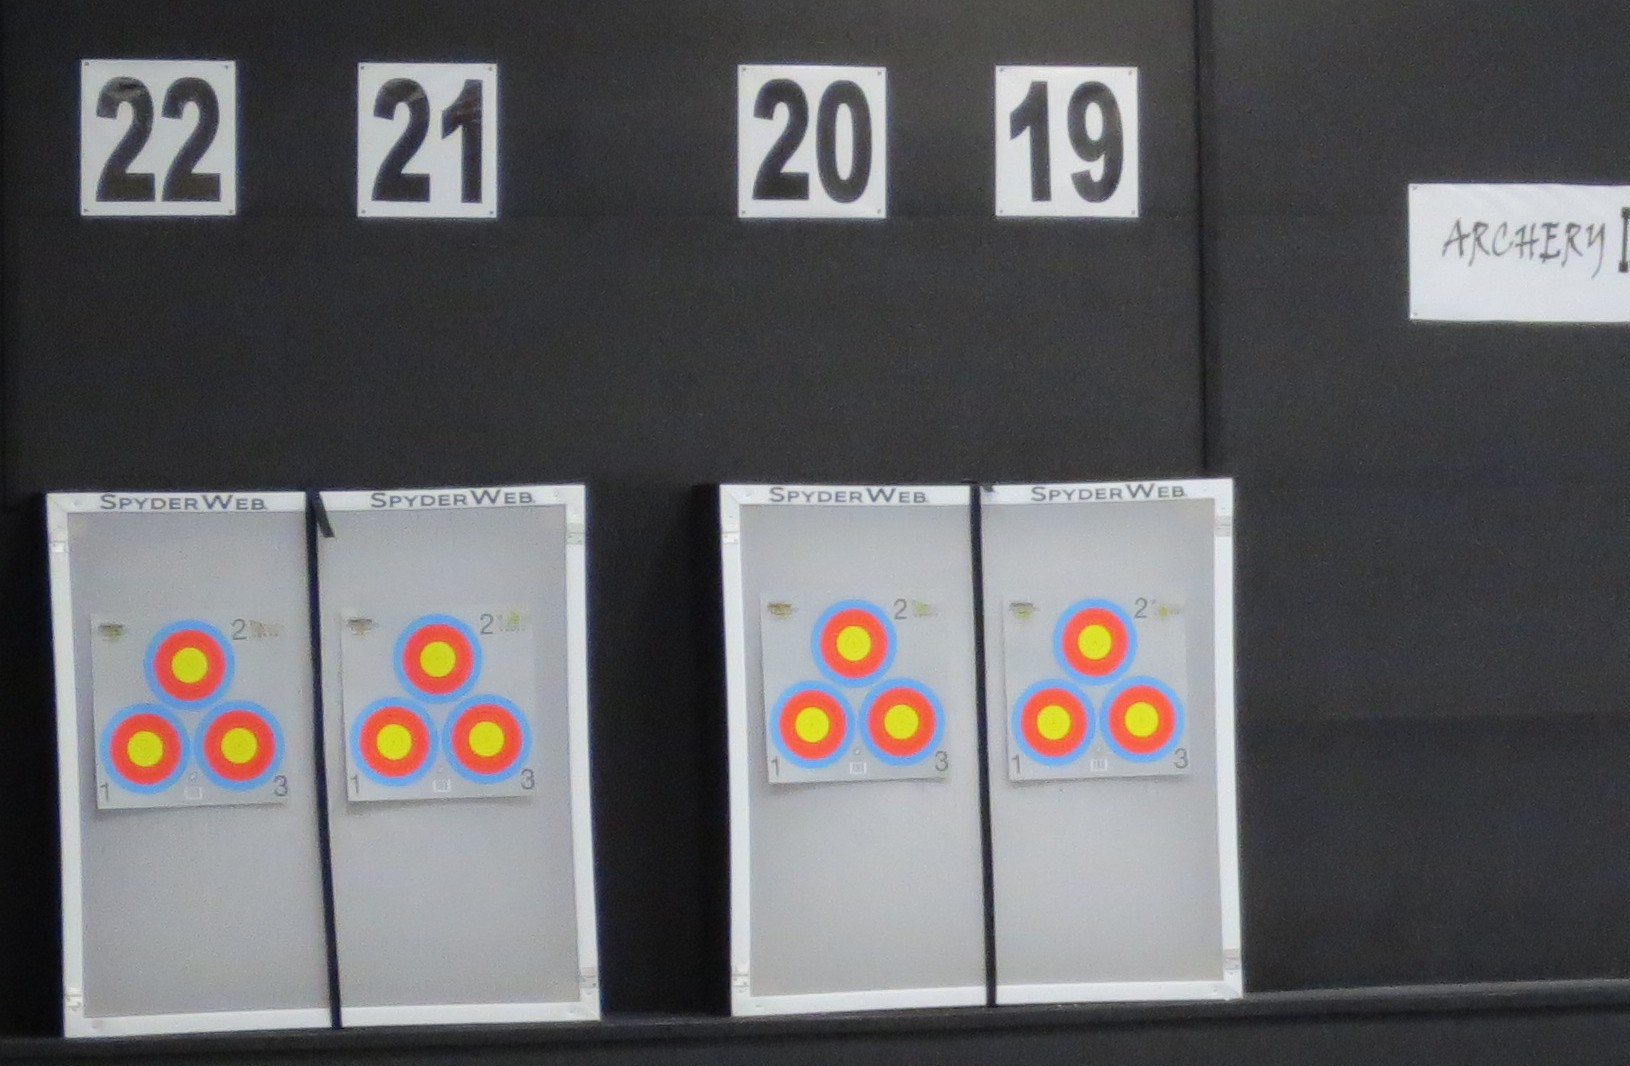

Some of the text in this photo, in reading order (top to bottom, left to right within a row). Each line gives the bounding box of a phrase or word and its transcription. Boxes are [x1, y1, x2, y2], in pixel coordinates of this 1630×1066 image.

[96, 77, 221, 202] 22
[371, 78, 482, 203] 21
[752, 79, 872, 203] 20
[1009, 80, 1124, 202] 19
[1442, 219, 1605, 278] ARCHERY
[894, 598, 908, 619] 2
[1134, 597, 1148, 618] 2
[231, 619, 247, 640] 2
[480, 613, 494, 634] 2
[935, 751, 949, 771] 3
[1173, 748, 1189, 769] 3
[273, 775, 288, 797] 3
[520, 768, 535, 790] 3
